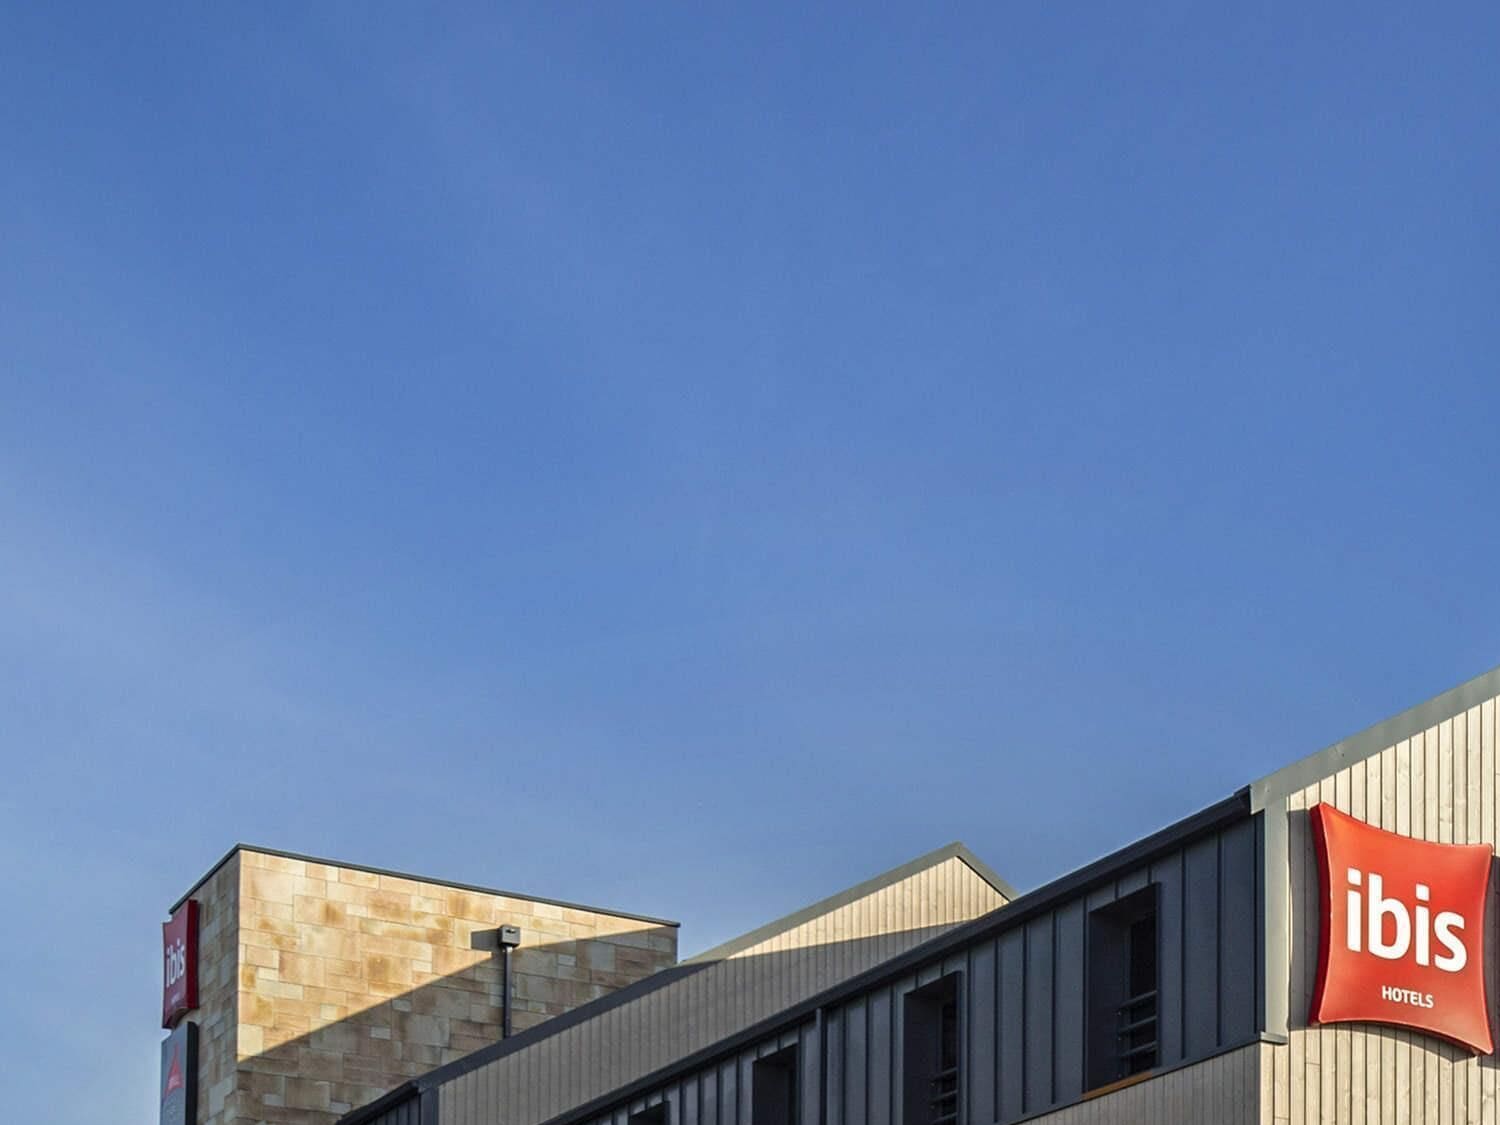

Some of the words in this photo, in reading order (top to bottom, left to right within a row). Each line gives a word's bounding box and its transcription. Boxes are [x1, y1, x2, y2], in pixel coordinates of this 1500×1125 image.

[1346, 867, 1468, 973] ibis
[166, 938, 185, 988] ibis
[1381, 985, 1434, 1009] HOTELS
